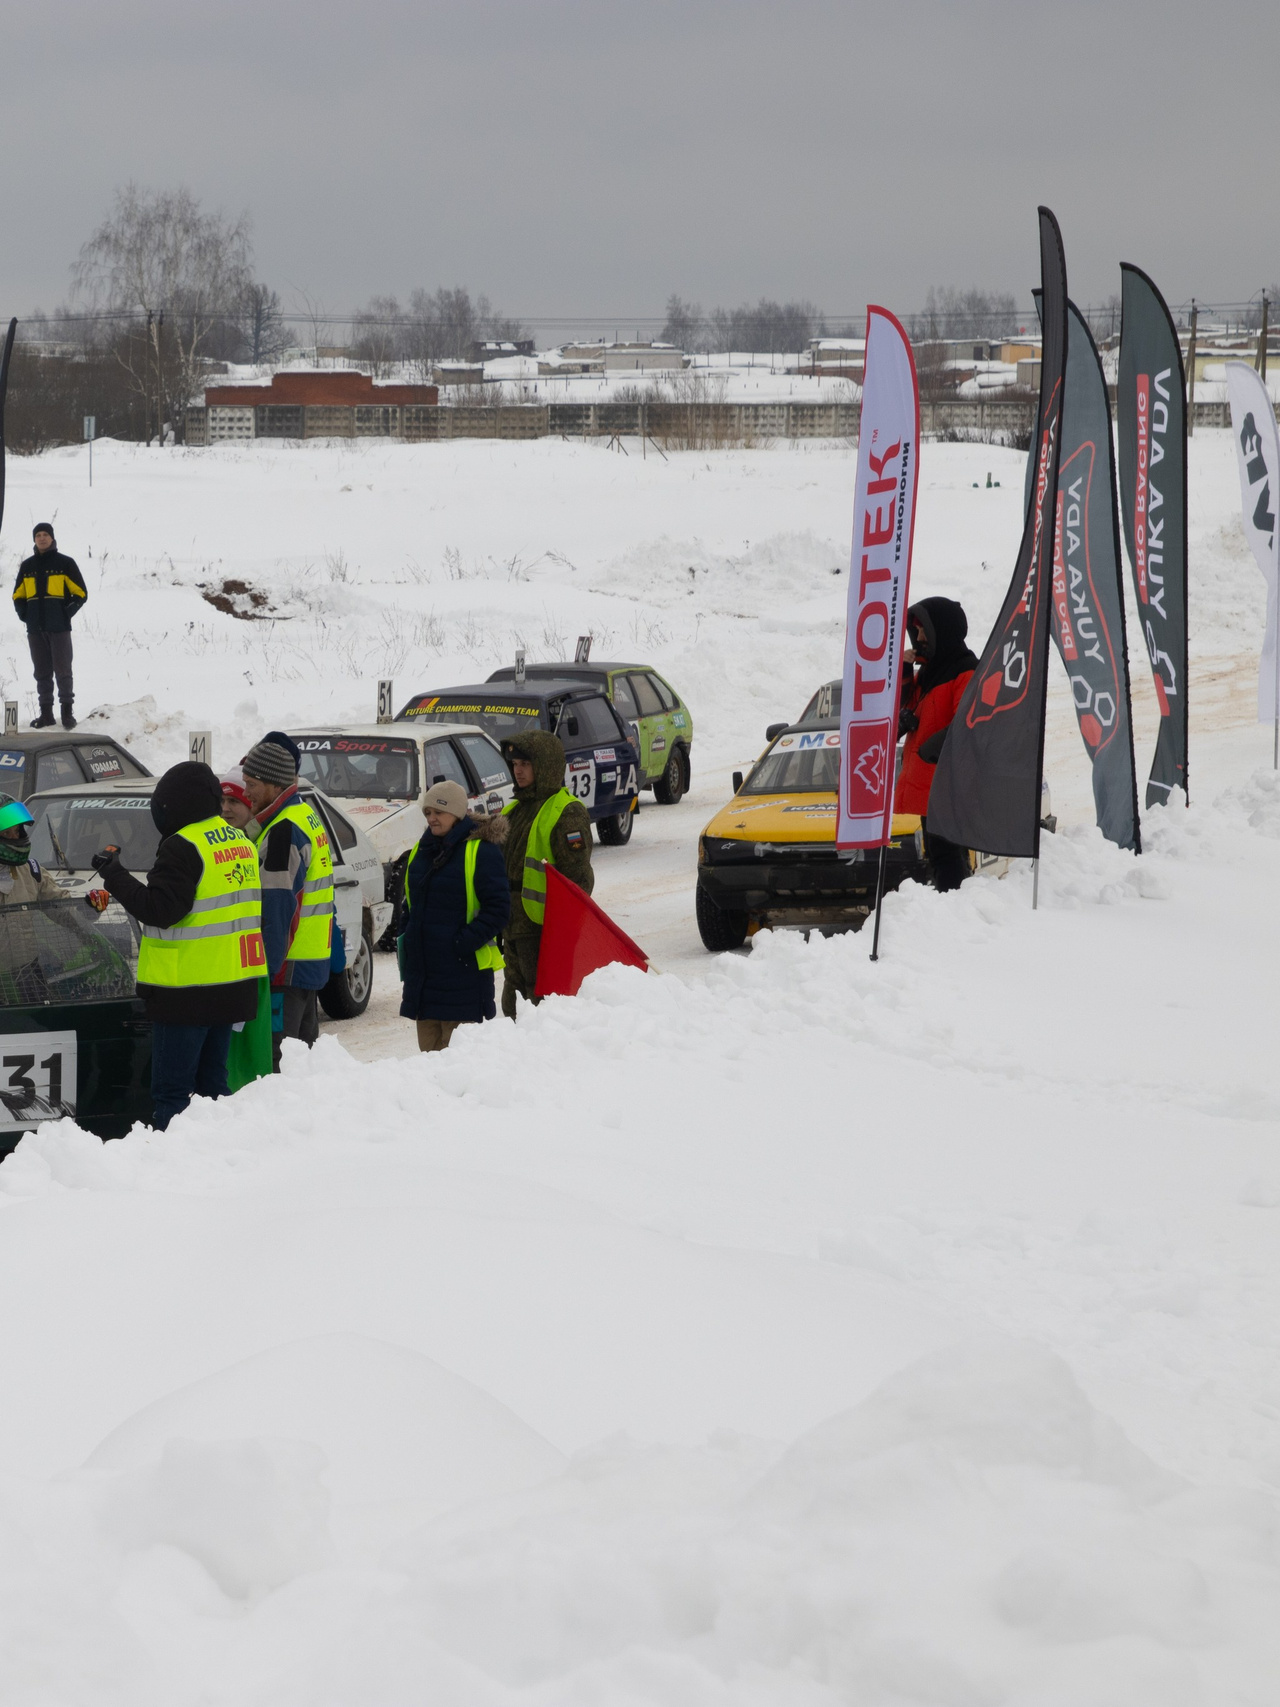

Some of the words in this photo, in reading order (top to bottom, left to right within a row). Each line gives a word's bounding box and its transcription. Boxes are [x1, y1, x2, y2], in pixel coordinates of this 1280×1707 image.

[894, 442, 910, 563] ТЕХНОЛОГИИ
[853, 434, 901, 712] TOTEK
[516, 657, 525, 675] 13
[379, 682, 392, 717] 51
[6, 707, 16, 726] 70
[405, 706, 434, 716] FUTURE
[435, 705, 482, 713] CHAMPIONS
[484, 705, 515, 714] RACING
[516, 707, 539, 717] TEAM
[297, 741, 331, 751] ADA
[334, 740, 388, 752] Sport
[90, 760, 120, 774] KRAMAR
[571, 773, 592, 798] 13
[3, 1052, 62, 1109] 31
